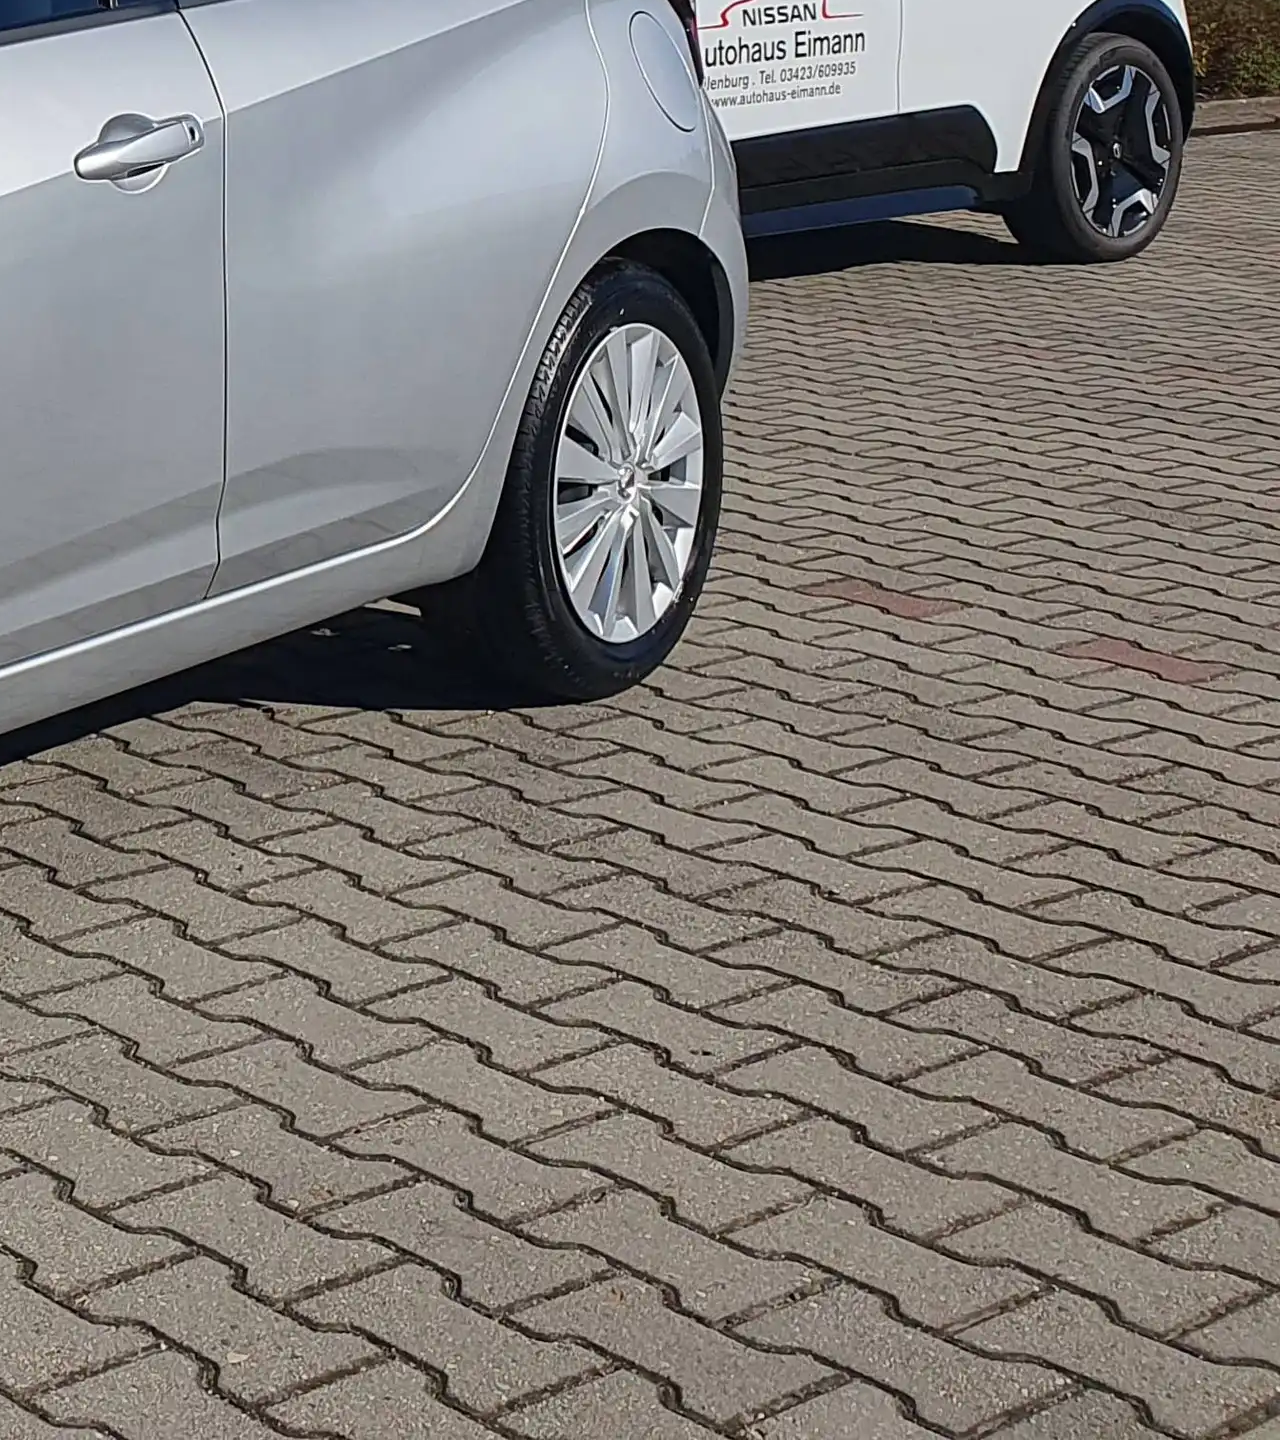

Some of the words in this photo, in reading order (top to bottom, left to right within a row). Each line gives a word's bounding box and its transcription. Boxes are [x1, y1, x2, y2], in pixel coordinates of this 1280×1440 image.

[742, 3, 817, 27] NISSAN
[703, 37, 786, 68] utohaus
[794, 30, 866, 59] Eimann
[760, 70, 776, 85] Tel.
[780, 61, 857, 83] 03423/609935
